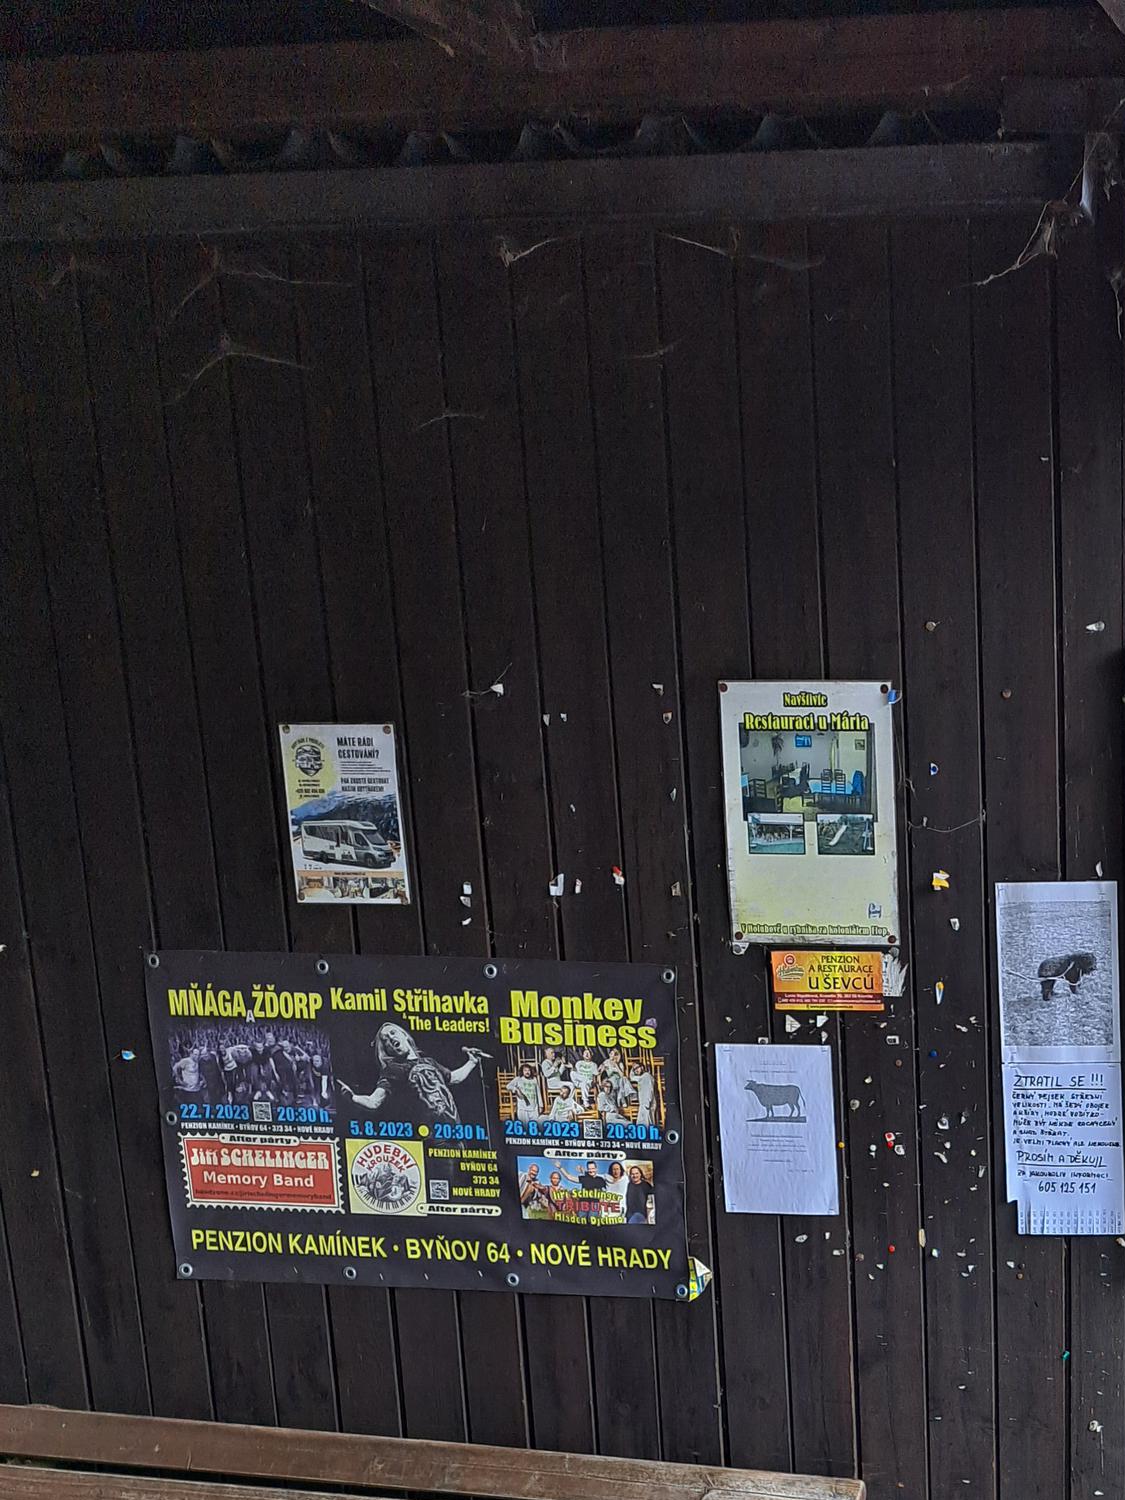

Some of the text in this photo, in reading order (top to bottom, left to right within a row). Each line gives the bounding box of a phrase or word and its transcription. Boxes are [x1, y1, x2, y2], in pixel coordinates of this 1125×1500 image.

[744, 711, 869, 731] Restauraci u Mária
[337, 736, 373, 746] MÁTE RÁDI
[338, 748, 379, 759] CESTOVÁNÍ?
[818, 965, 872, 973] RESTAURACE
[809, 977, 818, 989] U
[167, 982, 247, 1017] MŇÁGA
[251, 984, 322, 1020] ŽĎORP
[329, 987, 489, 1014] Kamil Střihavka
[510, 990, 643, 1024] Monkey
[408, 1016, 432, 1031] The
[435, 1017, 490, 1032] Leaders!
[499, 1017, 657, 1049] Business
[1013, 1073, 1104, 1087] ZTRATIL SE !!!
[277, 1106, 317, 1123] 20:30
[319, 1110, 333, 1123] h.
[434, 1123, 473, 1139] 20:30
[475, 1125, 488, 1140] h.
[607, 1124, 646, 1139] 20:30
[649, 1126, 662, 1140] h.
[221, 1148, 329, 1169] SCHELINGER
[357, 1144, 417, 1169] HUDEBNÍ
[428, 1148, 497, 1159] PENZION KAMÍNEK
[1016, 1149, 1054, 1162] PROSÍM
[1058, 1154, 1065, 1163] A
[487, 1162, 498, 1172] 64
[203, 1171, 314, 1189] Memory Band
[472, 1176, 500, 1185] 373 34
[1038, 1182, 1096, 1193] 605 125 151
[452, 1187, 500, 1197] NOVÉ HRADY
[428, 1205, 457, 1213] After
[557, 1199, 621, 1212] TRIBUTE
[191, 1229, 672, 1270] PENZION KAMÍNEK BYŇOV 64 NOVÉ HRADY
